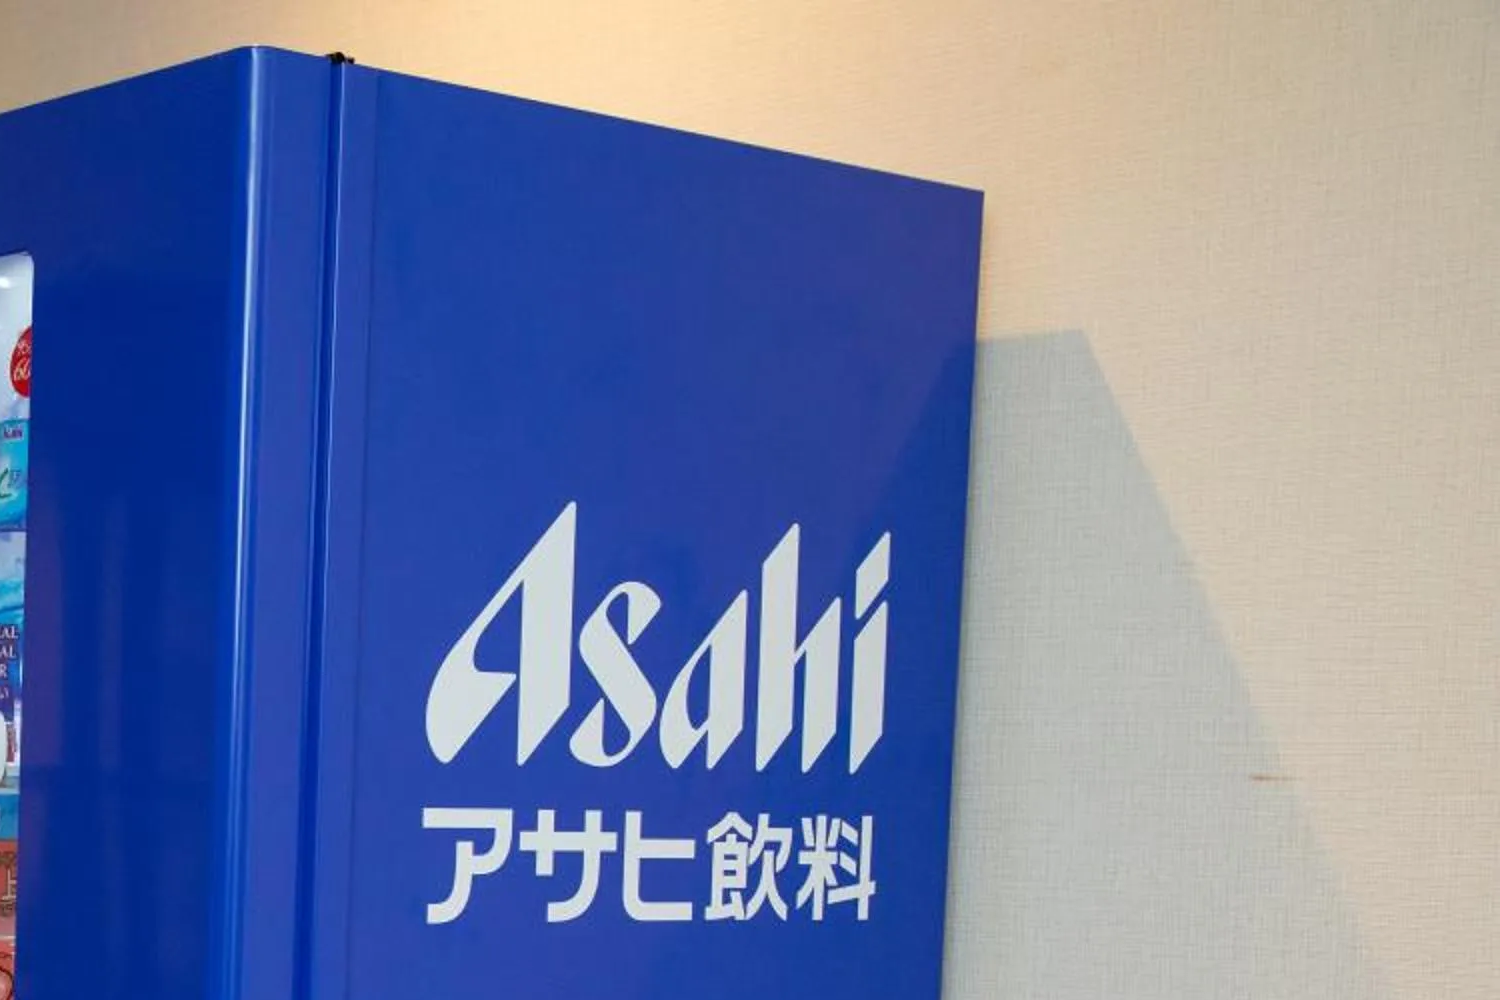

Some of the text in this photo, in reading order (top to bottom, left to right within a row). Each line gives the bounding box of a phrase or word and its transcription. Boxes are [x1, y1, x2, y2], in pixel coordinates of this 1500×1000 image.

[426, 500, 891, 775] Asahi
[422, 806, 877, 924] アサヒ飲料
